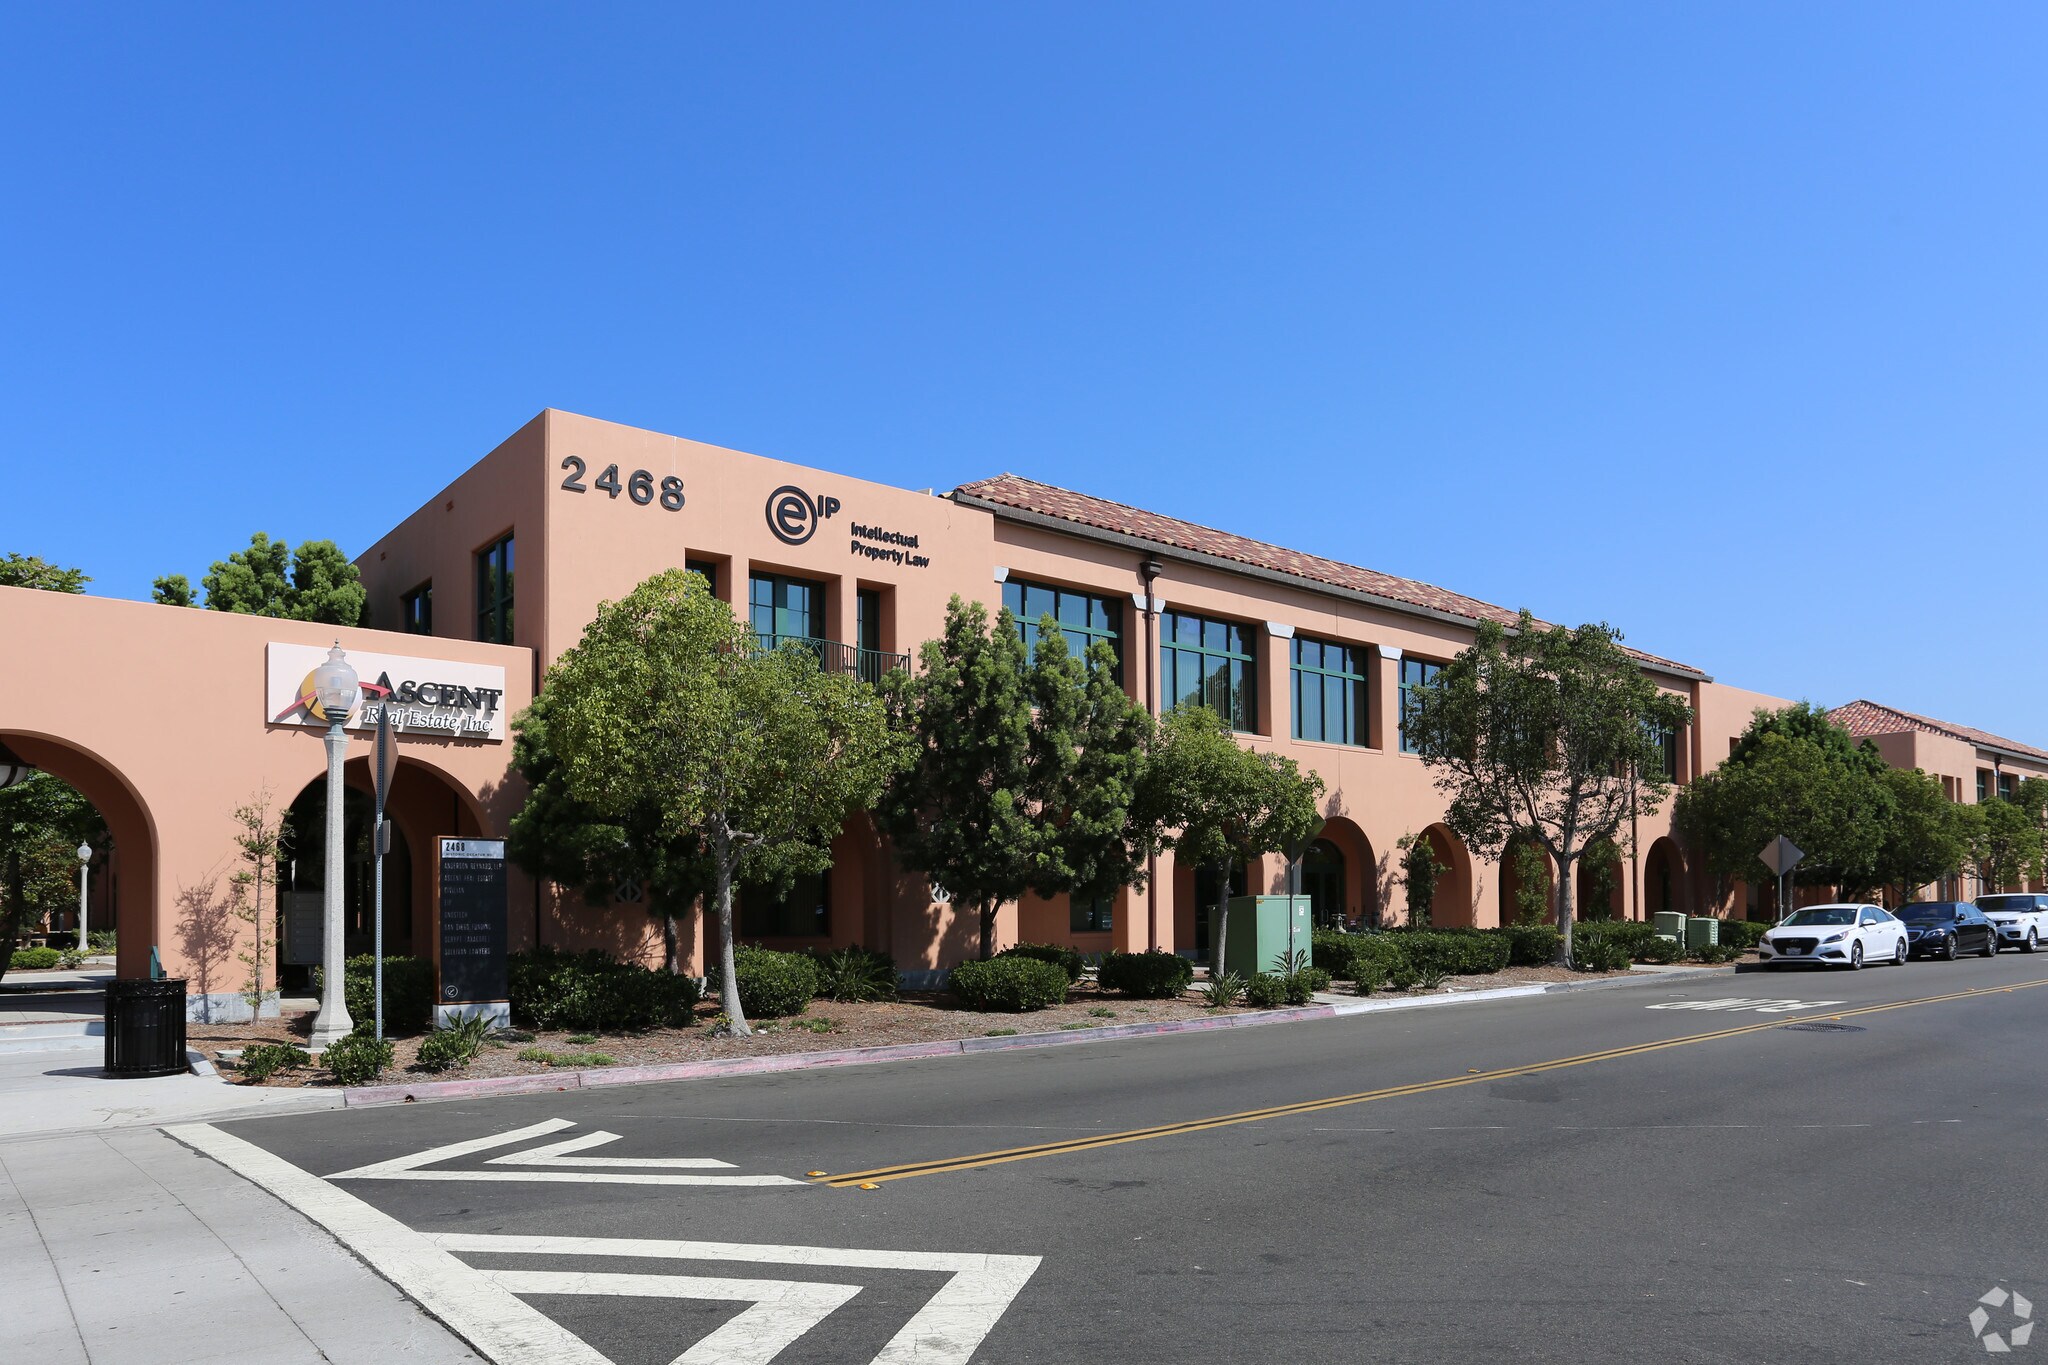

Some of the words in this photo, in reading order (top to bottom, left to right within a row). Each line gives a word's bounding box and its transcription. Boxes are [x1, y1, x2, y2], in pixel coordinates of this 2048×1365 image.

[561, 455, 686, 512] 2468
[850, 521, 919, 549] Intellectual
[850, 539, 904, 566] Property
[905, 549, 930, 568] Law
[366, 671, 503, 711] ASCENT
[366, 705, 402, 726] Ral
[408, 709, 461, 732] Estate,
[465, 714, 494, 732] Inc.
[446, 842, 465, 852] 2468
